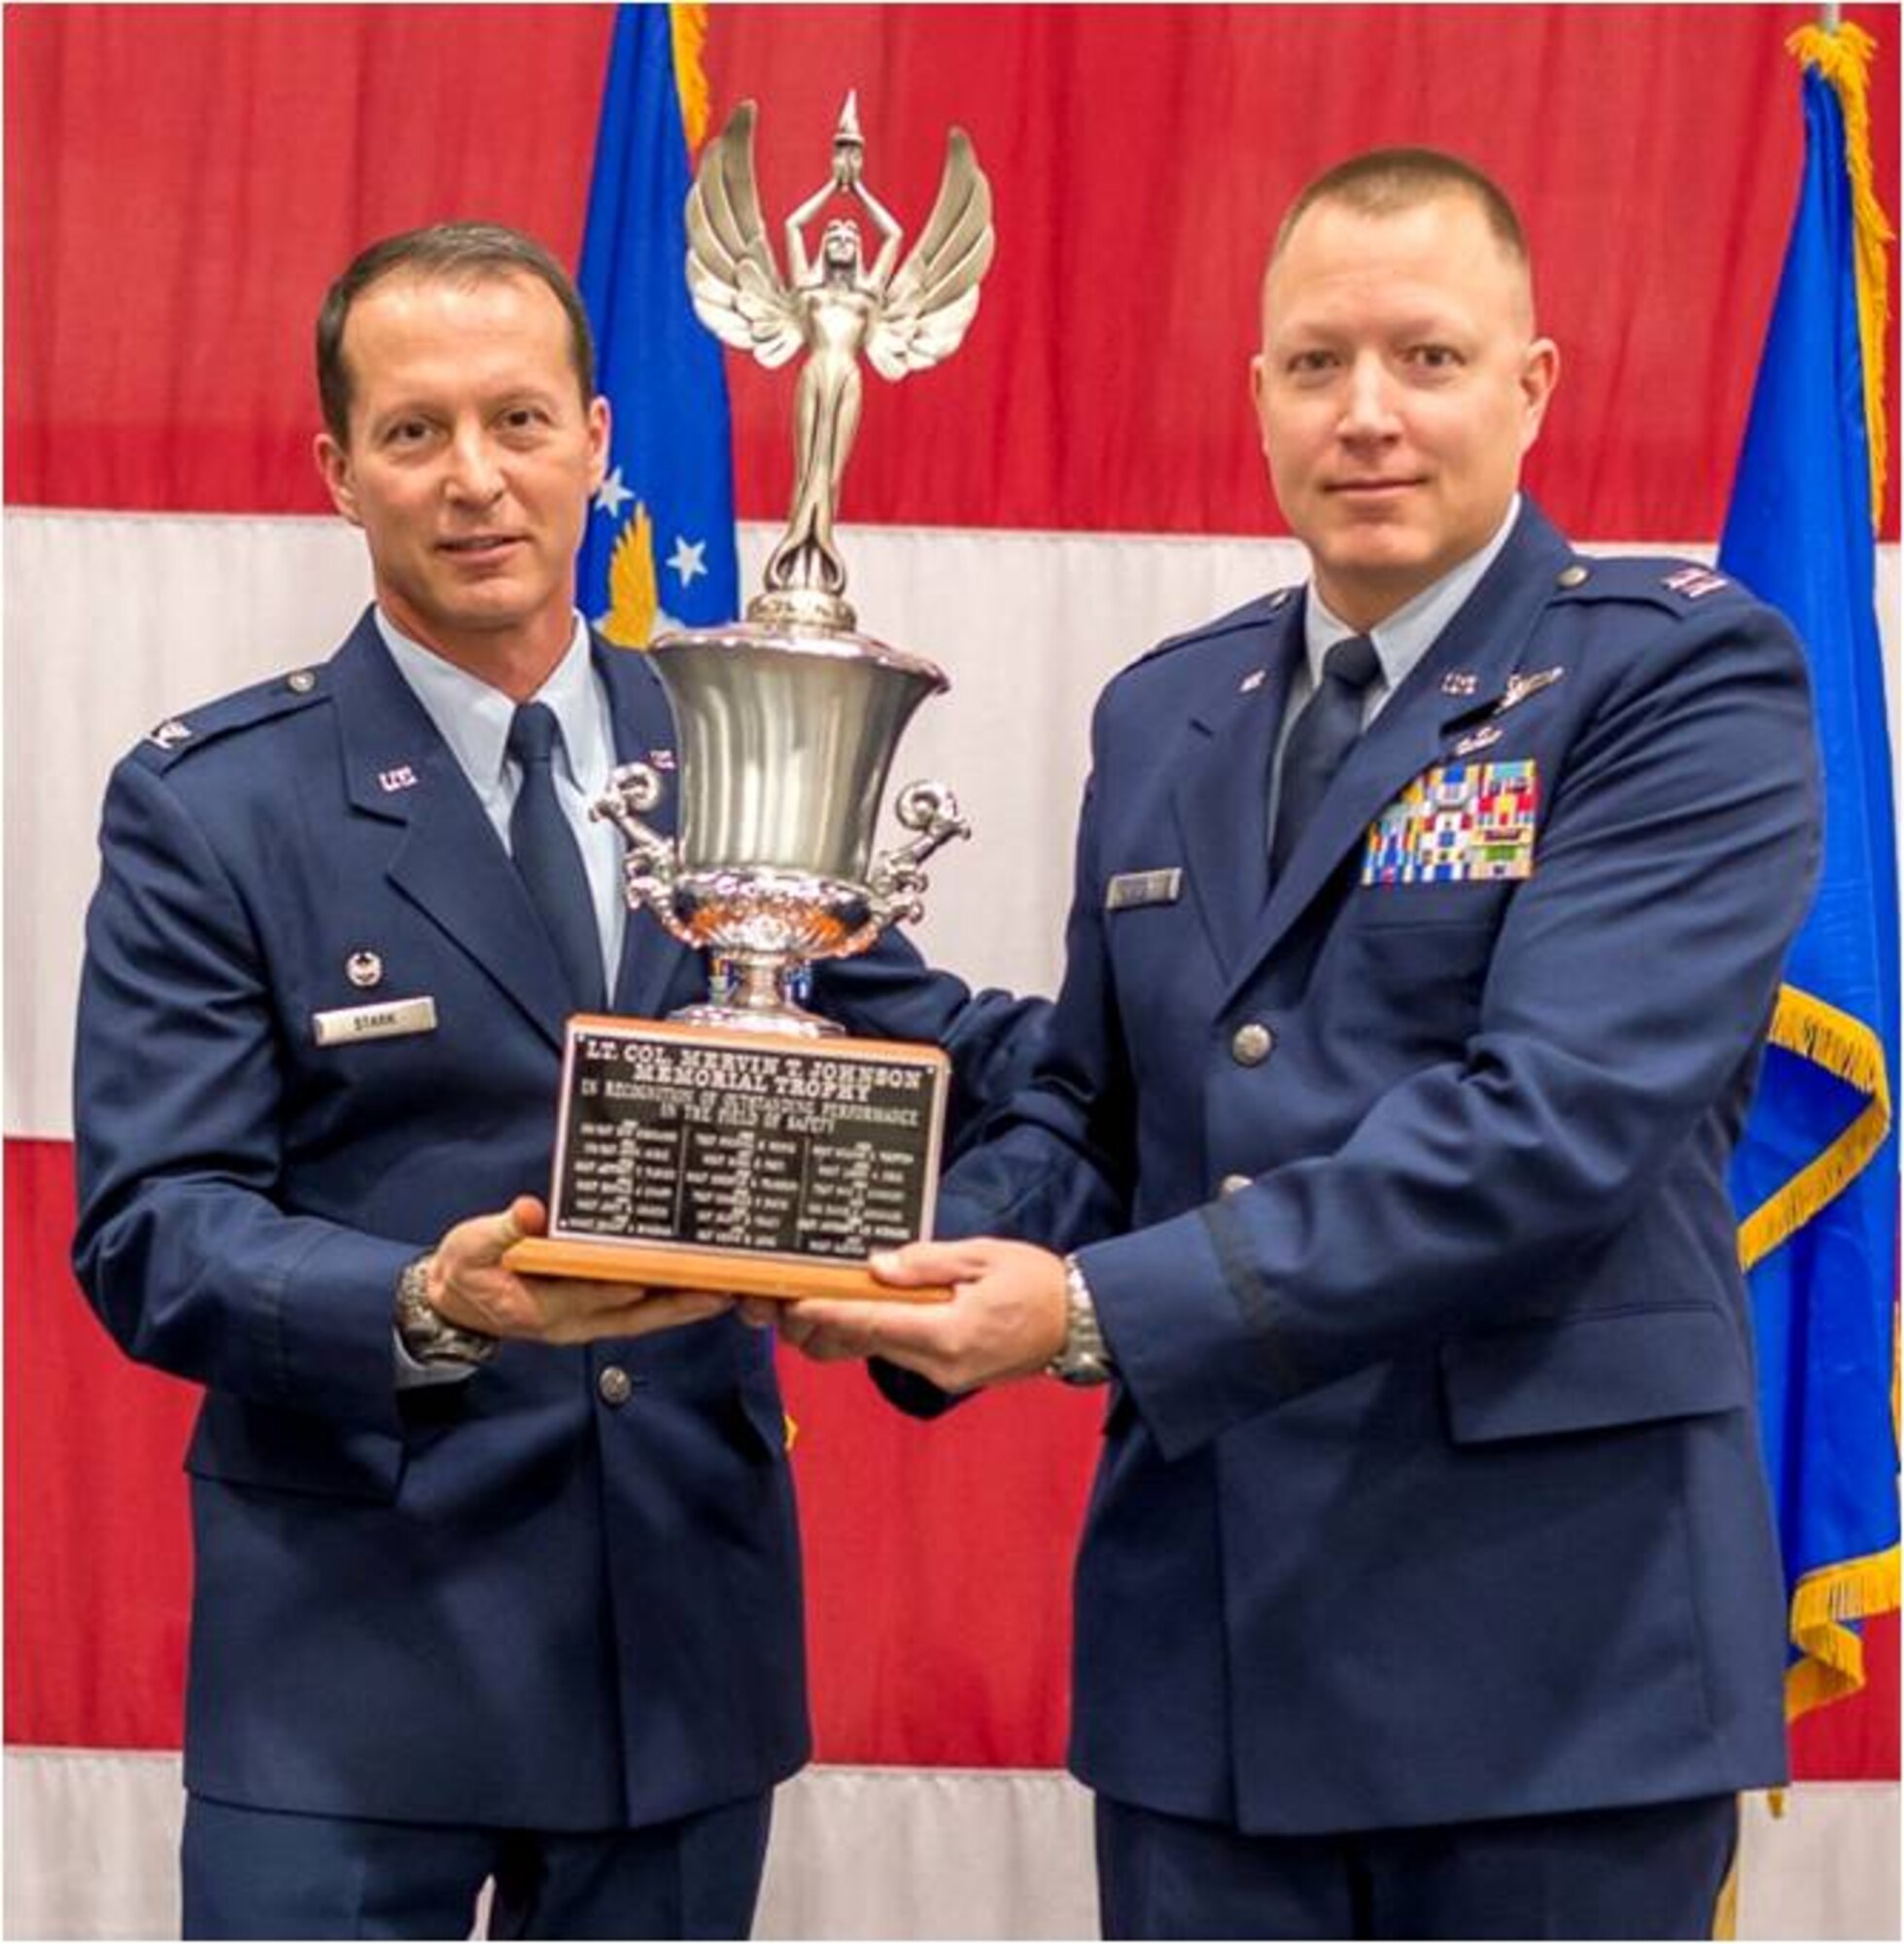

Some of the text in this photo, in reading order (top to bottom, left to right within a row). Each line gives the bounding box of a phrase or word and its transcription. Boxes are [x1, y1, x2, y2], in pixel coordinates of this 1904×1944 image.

[354, 1014, 397, 1030] STARK
[586, 1040, 617, 1060] LT.
[680, 1050, 779, 1076] MERVIN
[808, 1061, 921, 1089] JOHNSON
[634, 1063, 871, 1101] MEMORIAL TROPHY
[582, 1078, 919, 1127] IN RECOGNITION OF OUTSTANDING PERFORMANCE
[660, 1100, 837, 1134] IN THE FIELD OF SAFETY
